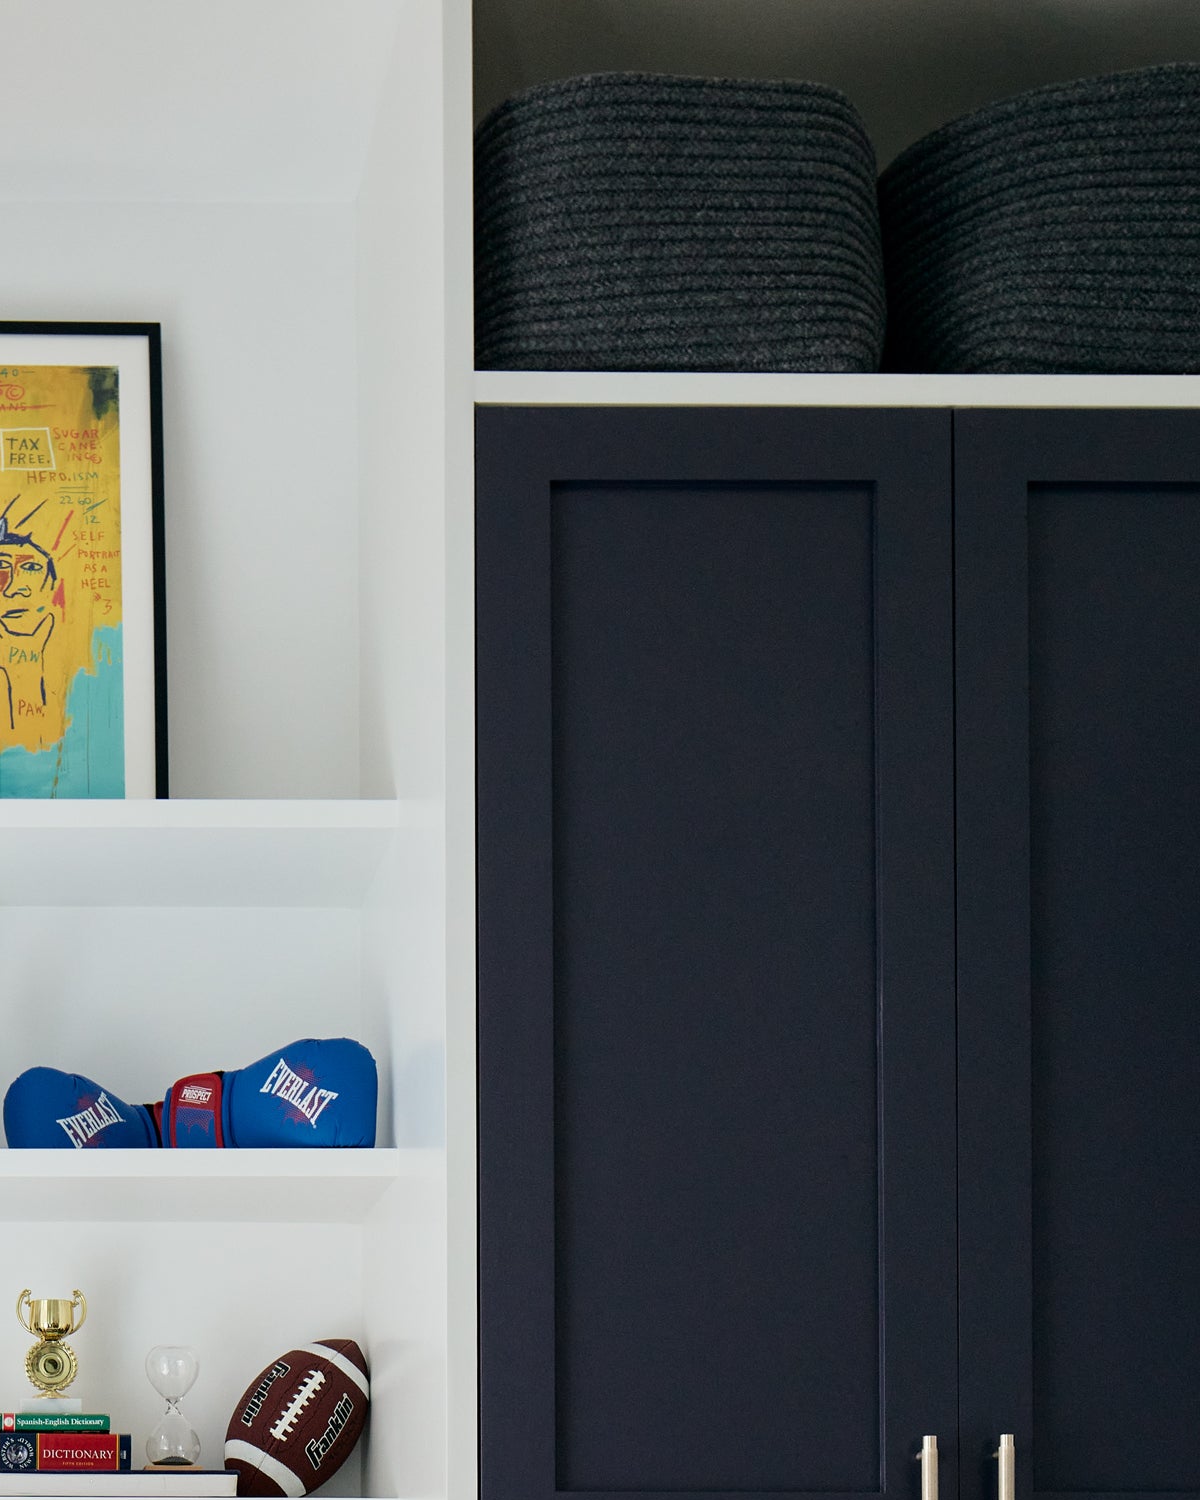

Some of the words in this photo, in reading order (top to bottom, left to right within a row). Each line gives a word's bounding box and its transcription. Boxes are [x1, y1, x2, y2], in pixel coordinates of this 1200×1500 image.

[52, 428, 100, 441] SUGAR
[5, 437, 41, 451] TAX
[73, 530, 106, 541] SELF
[83, 563, 99, 573] AS
[100, 563, 109, 573] A
[81, 579, 112, 590] HEEL
[8, 646, 41, 664] PAW
[180, 1088, 213, 1103] PROSPECT
[259, 1058, 339, 1128] EVERLAST
[55, 1090, 125, 1150] EVERLAST
[16, 1417, 70, 1427] Spanish-English
[70, 1417, 105, 1426] Dictionary
[42, 1449, 114, 1459] DICTIONARY
